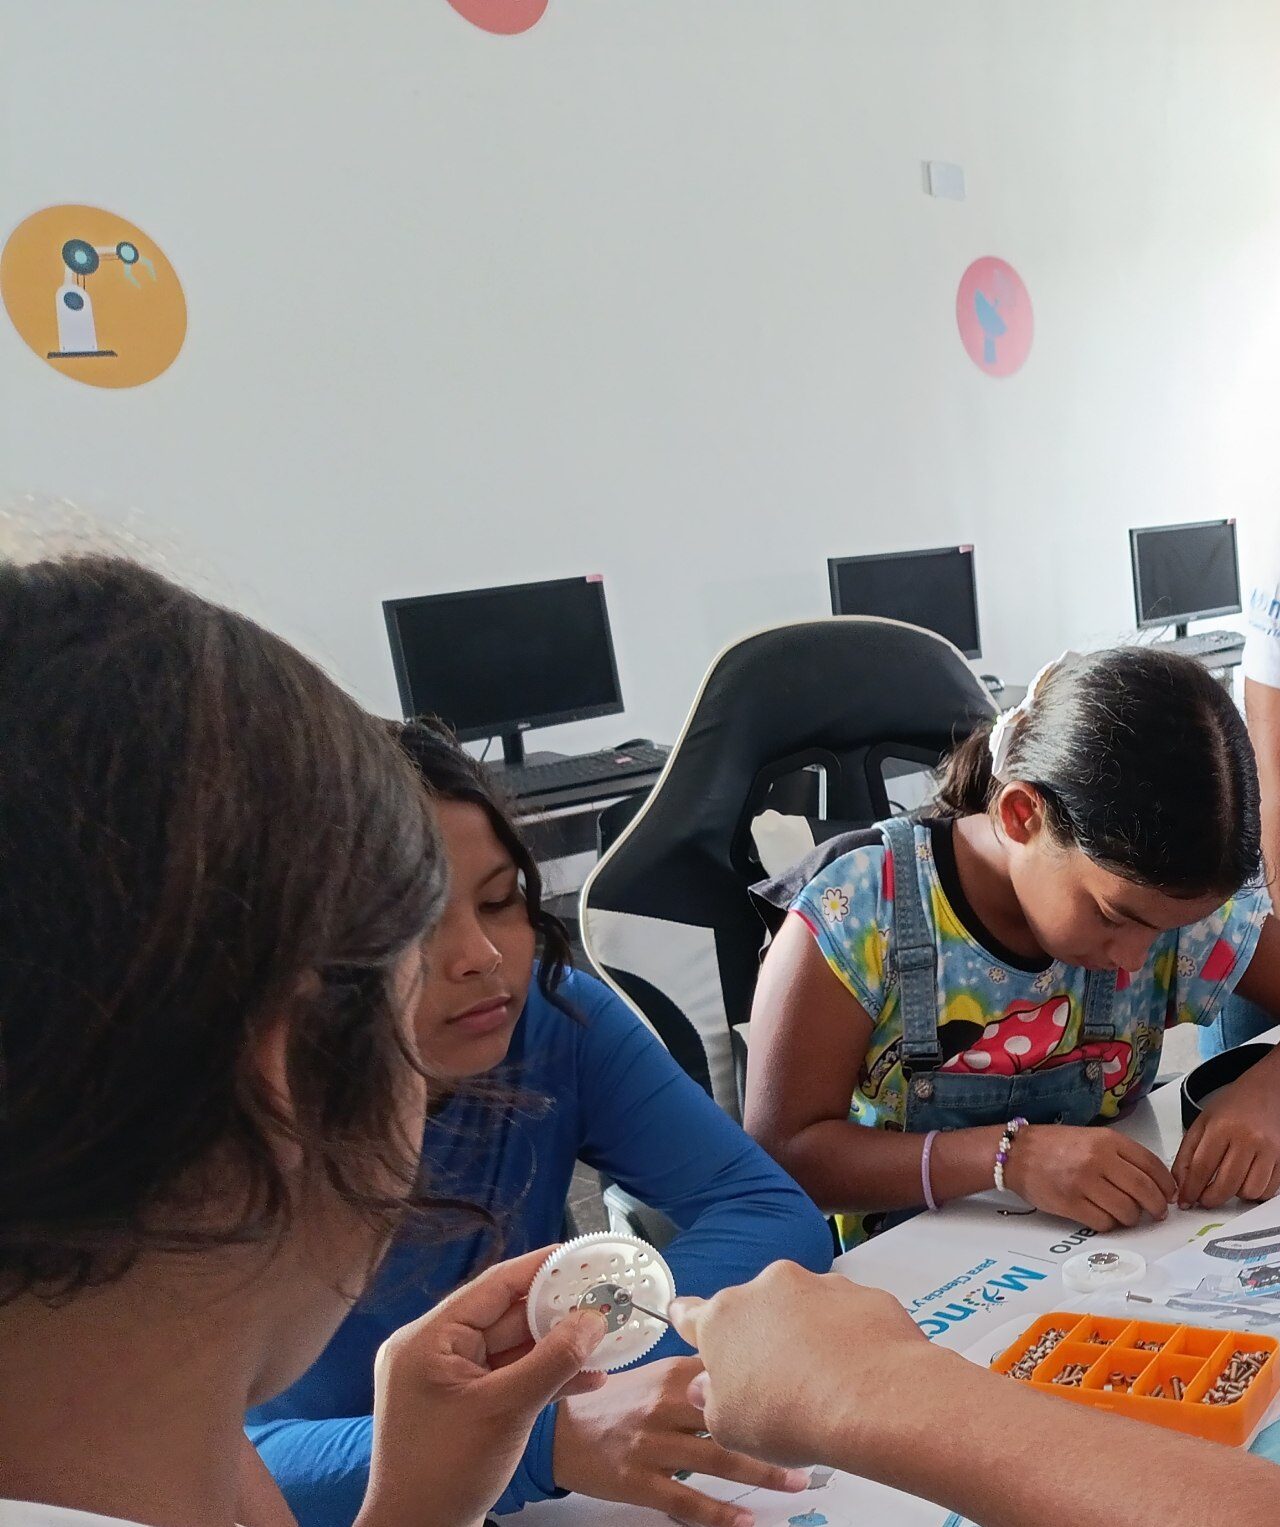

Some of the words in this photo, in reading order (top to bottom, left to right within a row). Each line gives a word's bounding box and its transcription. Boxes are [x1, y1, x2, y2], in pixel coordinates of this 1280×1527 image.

[1049, 1227, 1099, 1254] ano
[966, 1258, 998, 1275] para
[922, 1275, 972, 1302] Ciencia
[912, 1298, 926, 1308] y
